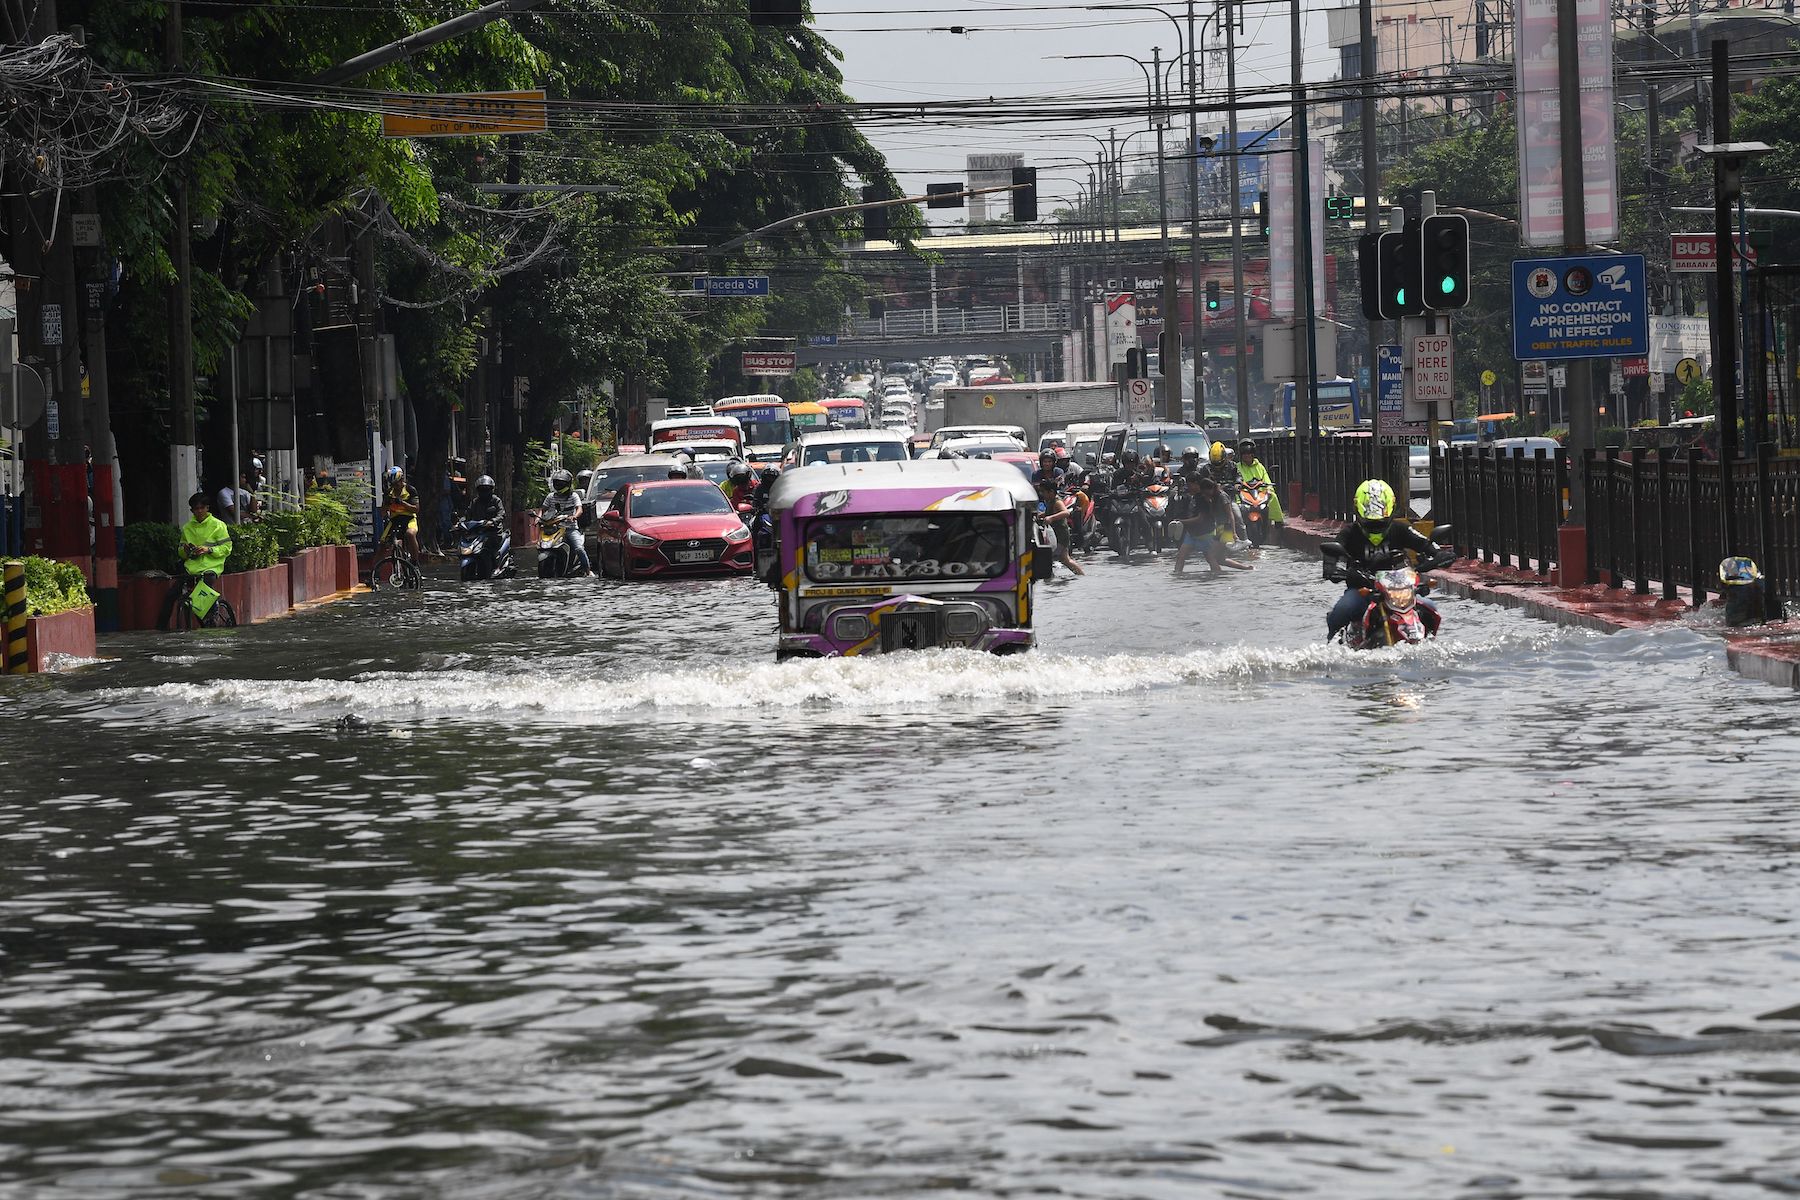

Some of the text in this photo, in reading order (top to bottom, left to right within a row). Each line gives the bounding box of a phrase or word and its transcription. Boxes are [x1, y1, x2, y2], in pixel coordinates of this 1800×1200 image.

[430, 123, 448, 132] CITY
[454, 123, 464, 131] OF
[969, 155, 1022, 169] WELCOME
[1327, 197, 1353, 219] 53
[1675, 241, 1711, 255] BUS
[703, 278, 759, 290] Maceda St
[1539, 300, 1622, 314] NO CONTACT
[1530, 312, 1632, 327] APPREHENSION
[1549, 325, 1613, 338] IN EFFECT
[1418, 340, 1448, 353] STOP
[1531, 338, 1633, 350] OBEY TRAFFIC RULES
[745, 357, 793, 366] BUS STOP
[1417, 357, 1448, 369] HERE
[1417, 372, 1449, 382] ON RED
[1418, 385, 1448, 395] SIGNAL
[1322, 413, 1350, 421] SEVEN
[1380, 435, 1428, 446] CM. RECTO
[814, 558, 998, 579] PLAYBOY
